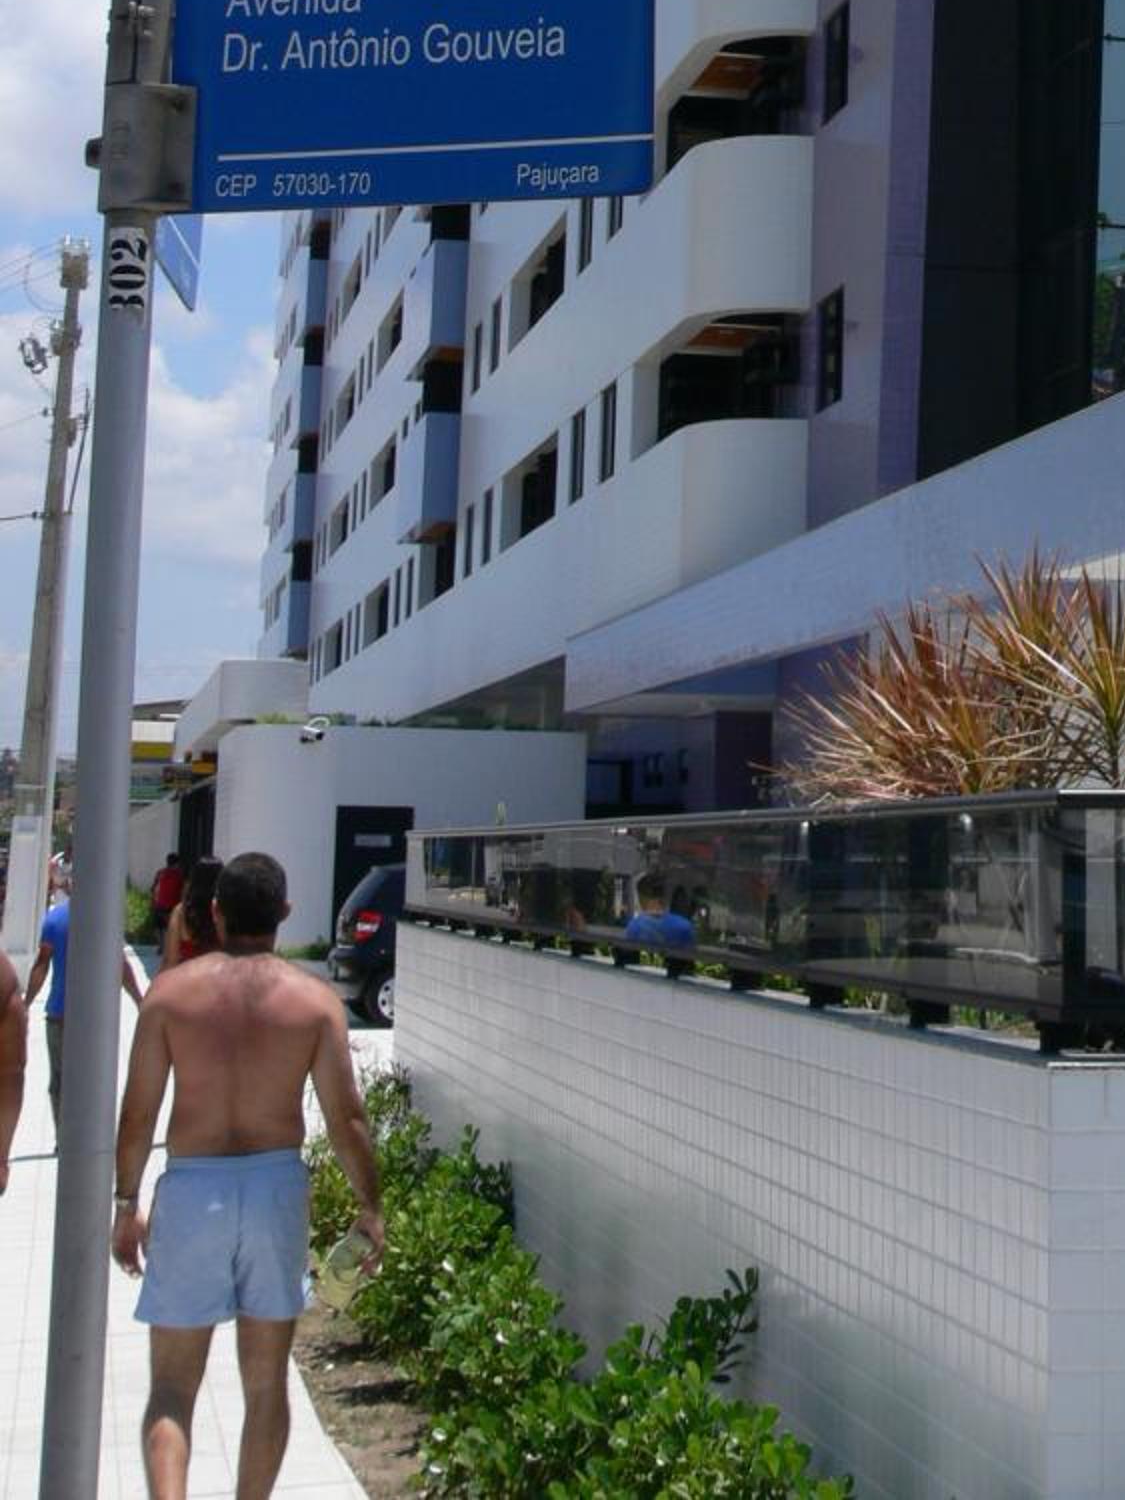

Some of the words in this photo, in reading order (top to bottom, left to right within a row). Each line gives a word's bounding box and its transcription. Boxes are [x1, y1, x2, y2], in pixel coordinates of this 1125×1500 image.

[222, 34, 269, 73] Dr.
[281, 27, 410, 71] Antônio
[423, 17, 566, 63] Gouveia
[215, 174, 257, 198] CEP
[272, 172, 372, 196] 57030-170
[516, 161, 600, 191] Pajuçara
